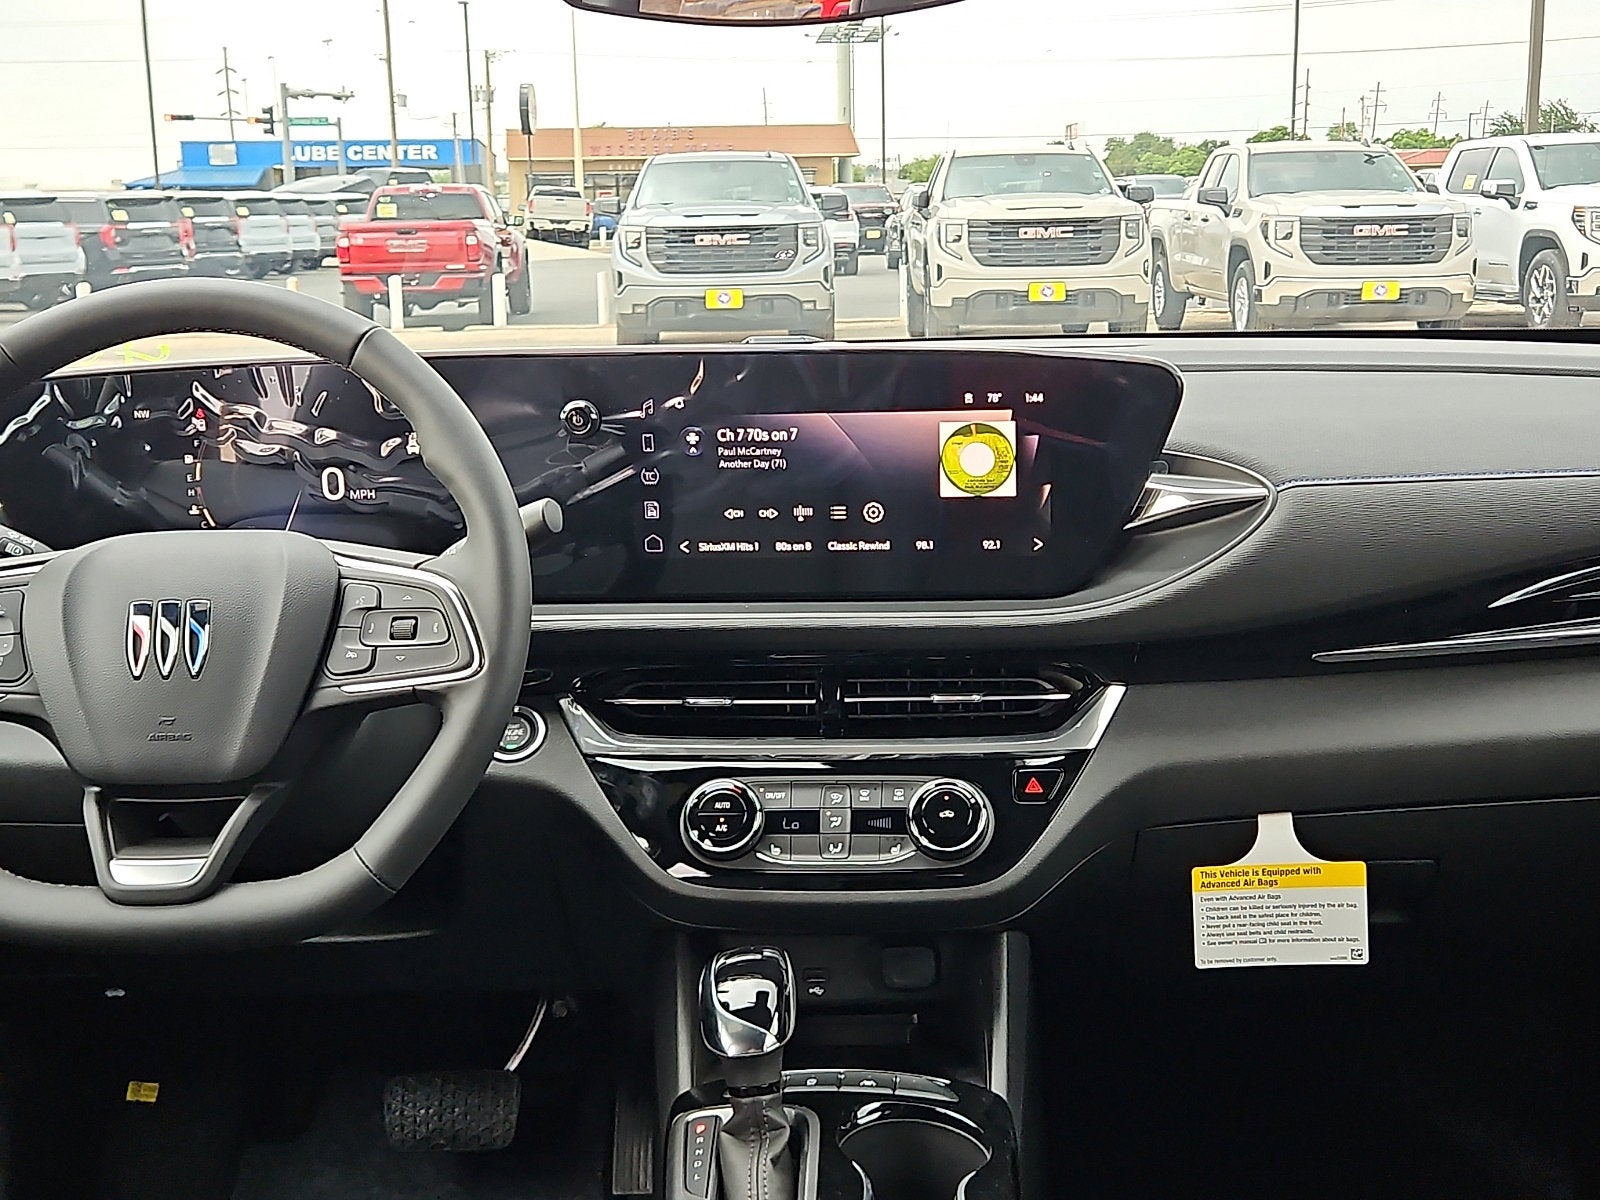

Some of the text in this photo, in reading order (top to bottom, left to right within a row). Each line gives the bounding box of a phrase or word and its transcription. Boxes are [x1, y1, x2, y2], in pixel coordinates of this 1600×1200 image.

[290, 144, 438, 161] UBE CENTER
[1018, 226, 1074, 239] GMC
[1353, 224, 1409, 237] GMC
[694, 233, 751, 246] GMC
[1025, 392, 1044, 403] 1:44
[133, 410, 150, 419] NW
[716, 427, 798, 441] Ch 7 70s on 7
[718, 447, 782, 457] Paul McCartney
[719, 459, 787, 470] Another Day (71)
[321, 466, 376, 501] 0 MPH
[699, 541, 735, 552] SiriusXM
[736, 541, 753, 551] Hits
[775, 541, 792, 551] 80s
[792, 543, 805, 551] on
[827, 540, 891, 551] Classic Rewind
[915, 540, 934, 550] 98.1
[982, 540, 1001, 550] 92.1
[147, 732, 193, 742] AIRBAG
[765, 792, 786, 800] ON/OFF
[715, 824, 728, 832] A/C
[1200, 871, 1217, 879] This
[1220, 869, 1250, 878] Vehicle
[1262, 867, 1301, 877] Equipped
[1303, 866, 1322, 875] with
[1200, 878, 1279, 889] Advanced Air Bags
[695, 1148, 704, 1156] N
